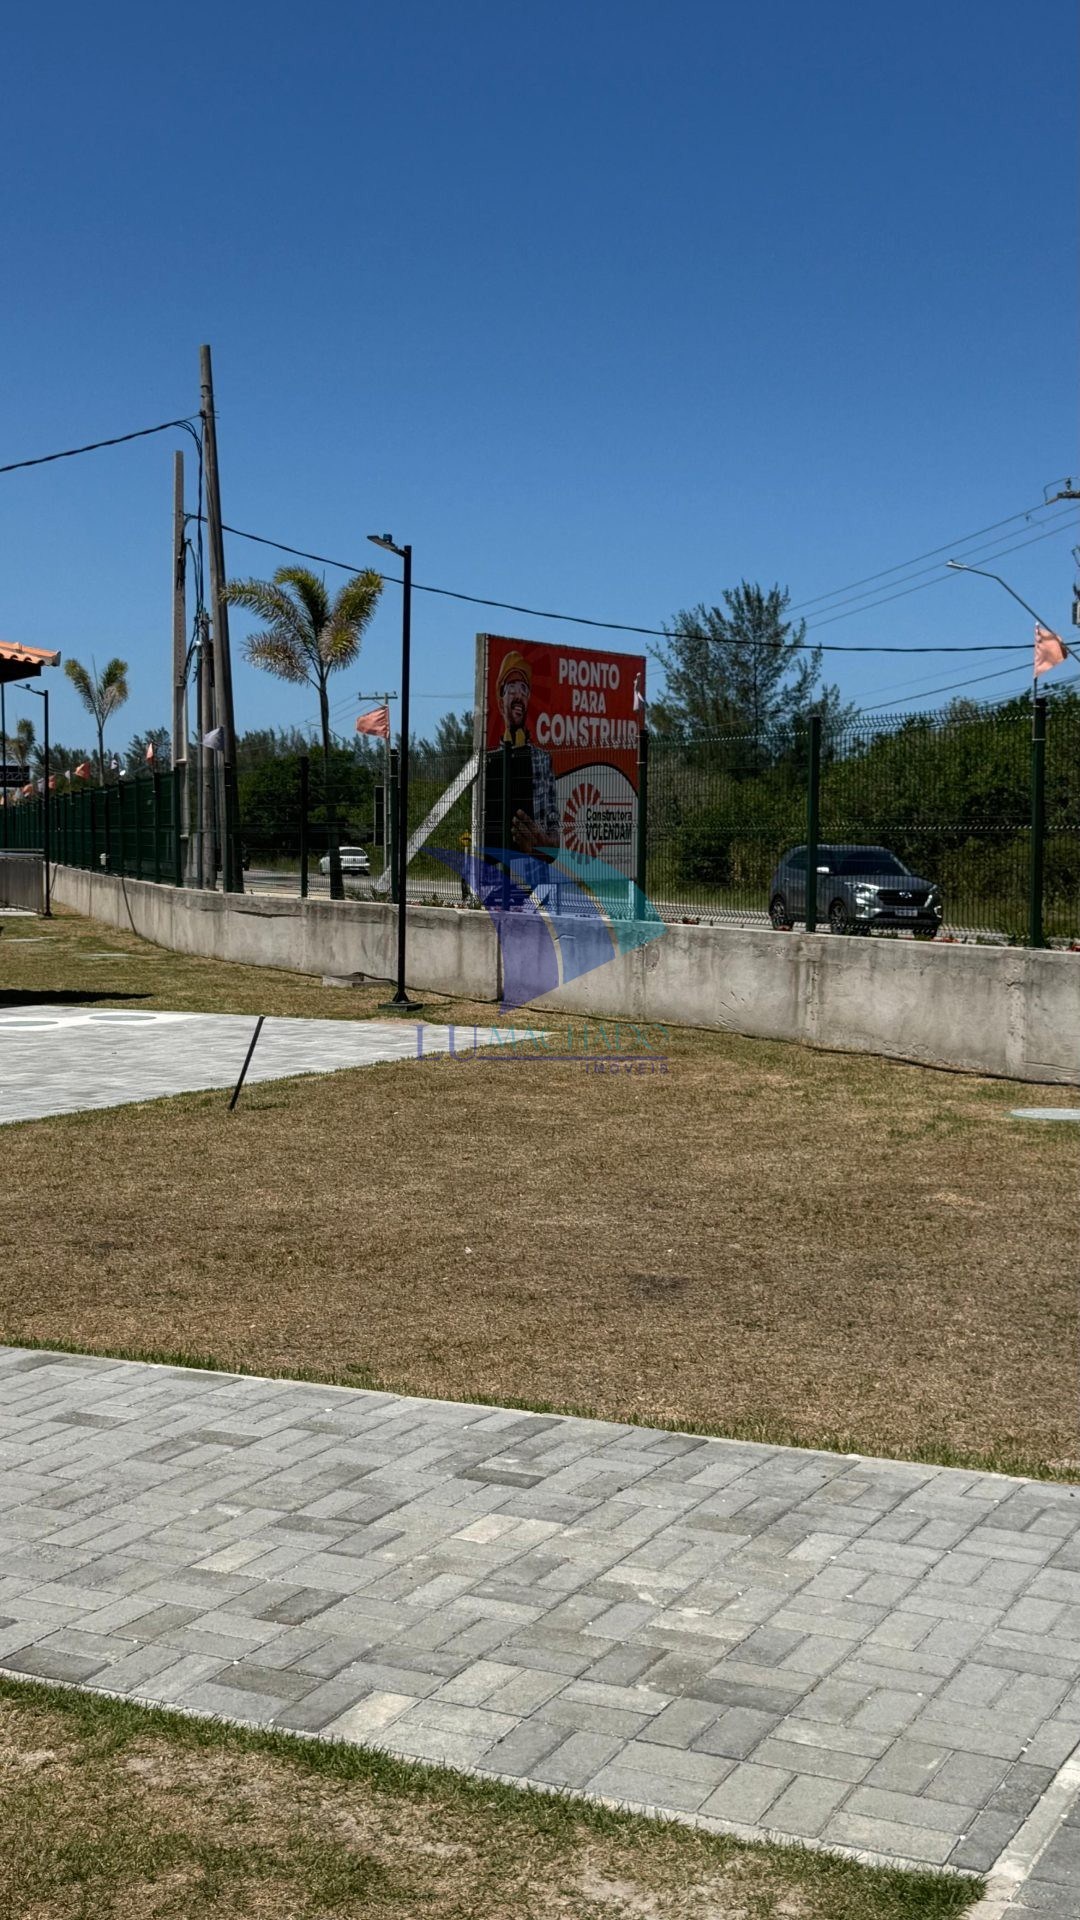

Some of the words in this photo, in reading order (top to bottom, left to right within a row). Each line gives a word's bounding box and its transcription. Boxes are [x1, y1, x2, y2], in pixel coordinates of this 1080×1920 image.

[558, 658, 620, 690] PRONTO
[572, 689, 607, 714] PARA
[536, 712, 639, 750] CONSTRUIR
[586, 808, 633, 822] Construtora
[585, 823, 633, 841] VOLENDAM
